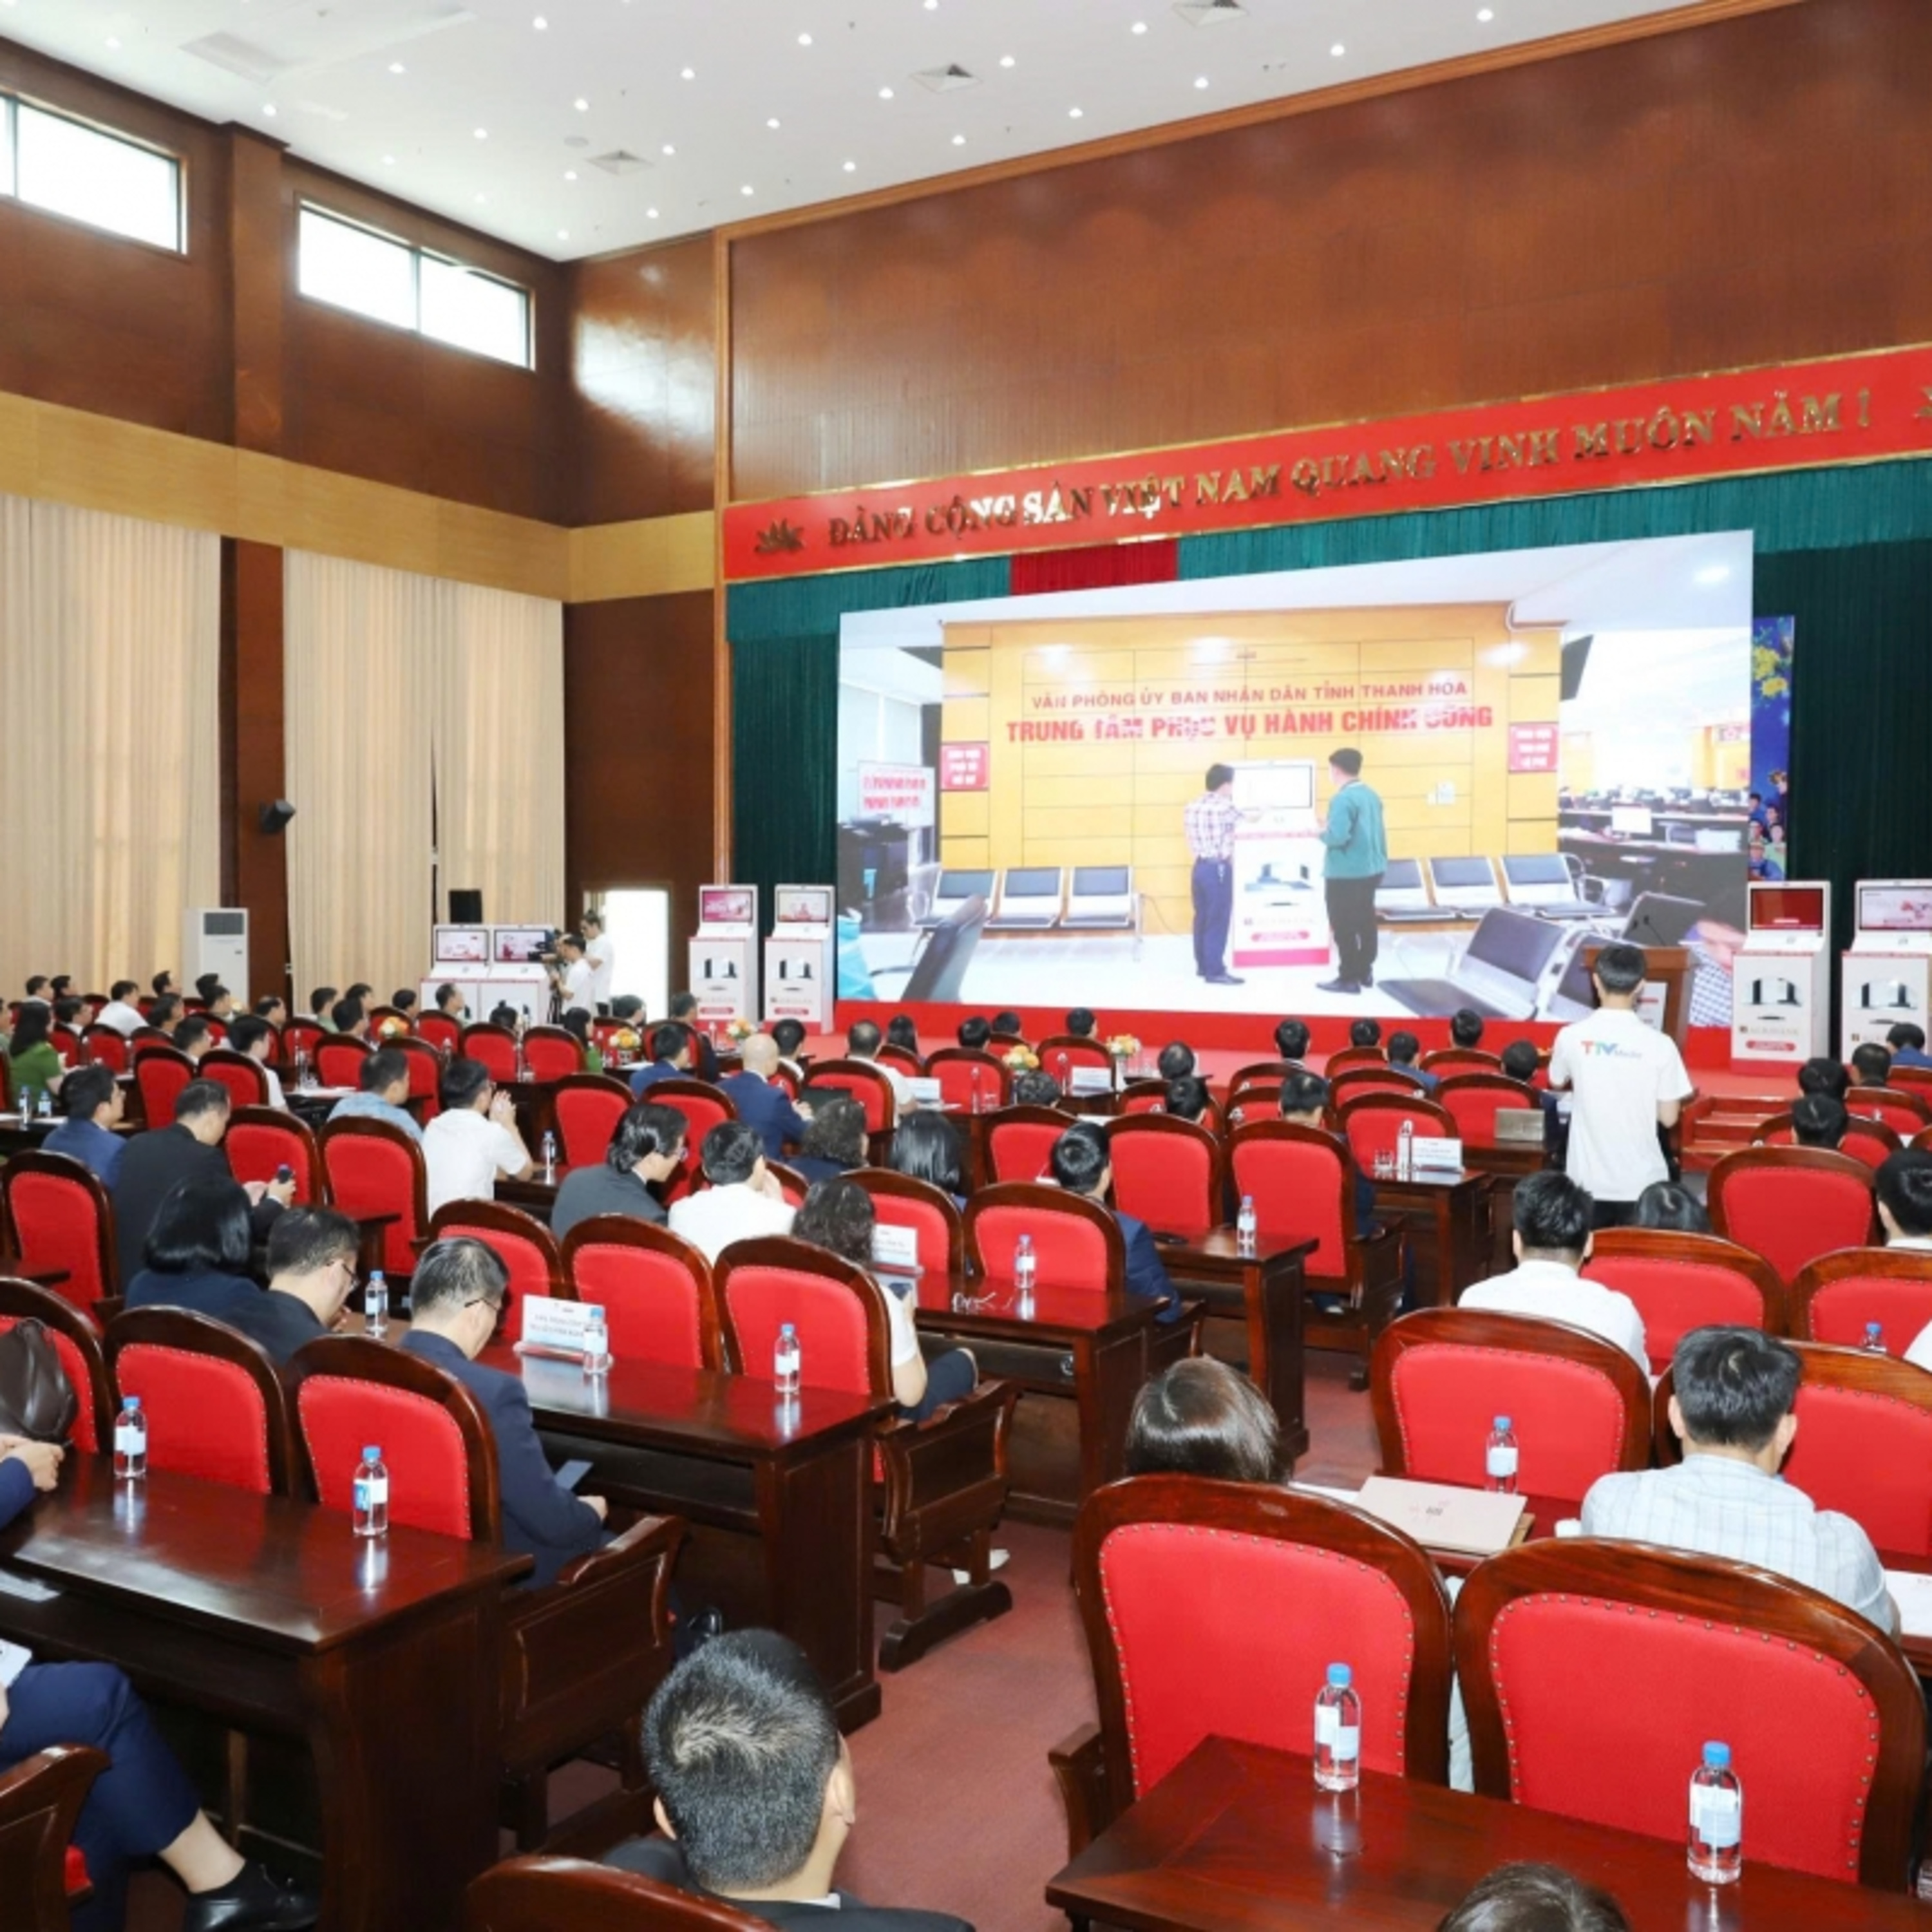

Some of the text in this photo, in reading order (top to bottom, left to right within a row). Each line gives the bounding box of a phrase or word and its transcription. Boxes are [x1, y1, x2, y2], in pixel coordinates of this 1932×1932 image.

[925, 494, 1018, 540] CỘNG
[1022, 480, 1093, 526] SẢN
[1099, 473, 1185, 519] VIỆT
[1195, 464, 1281, 505] NAM
[1290, 444, 1436, 497] QUANG
[1448, 428, 1560, 475] VINH
[1572, 404, 1716, 459] MUÔN
[1729, 390, 1842, 442] NĂM
[1072, 689, 1135, 708] PHÒNG
[1171, 690, 1208, 705] BAN
[1213, 685, 1264, 703] NHÂN
[1270, 683, 1307, 701] DÂN
[1361, 681, 1423, 699] THANH
[1007, 719, 1084, 743] TRUNG
[1224, 714, 1255, 741] VỤ
[1264, 708, 1333, 734] HÀNH
